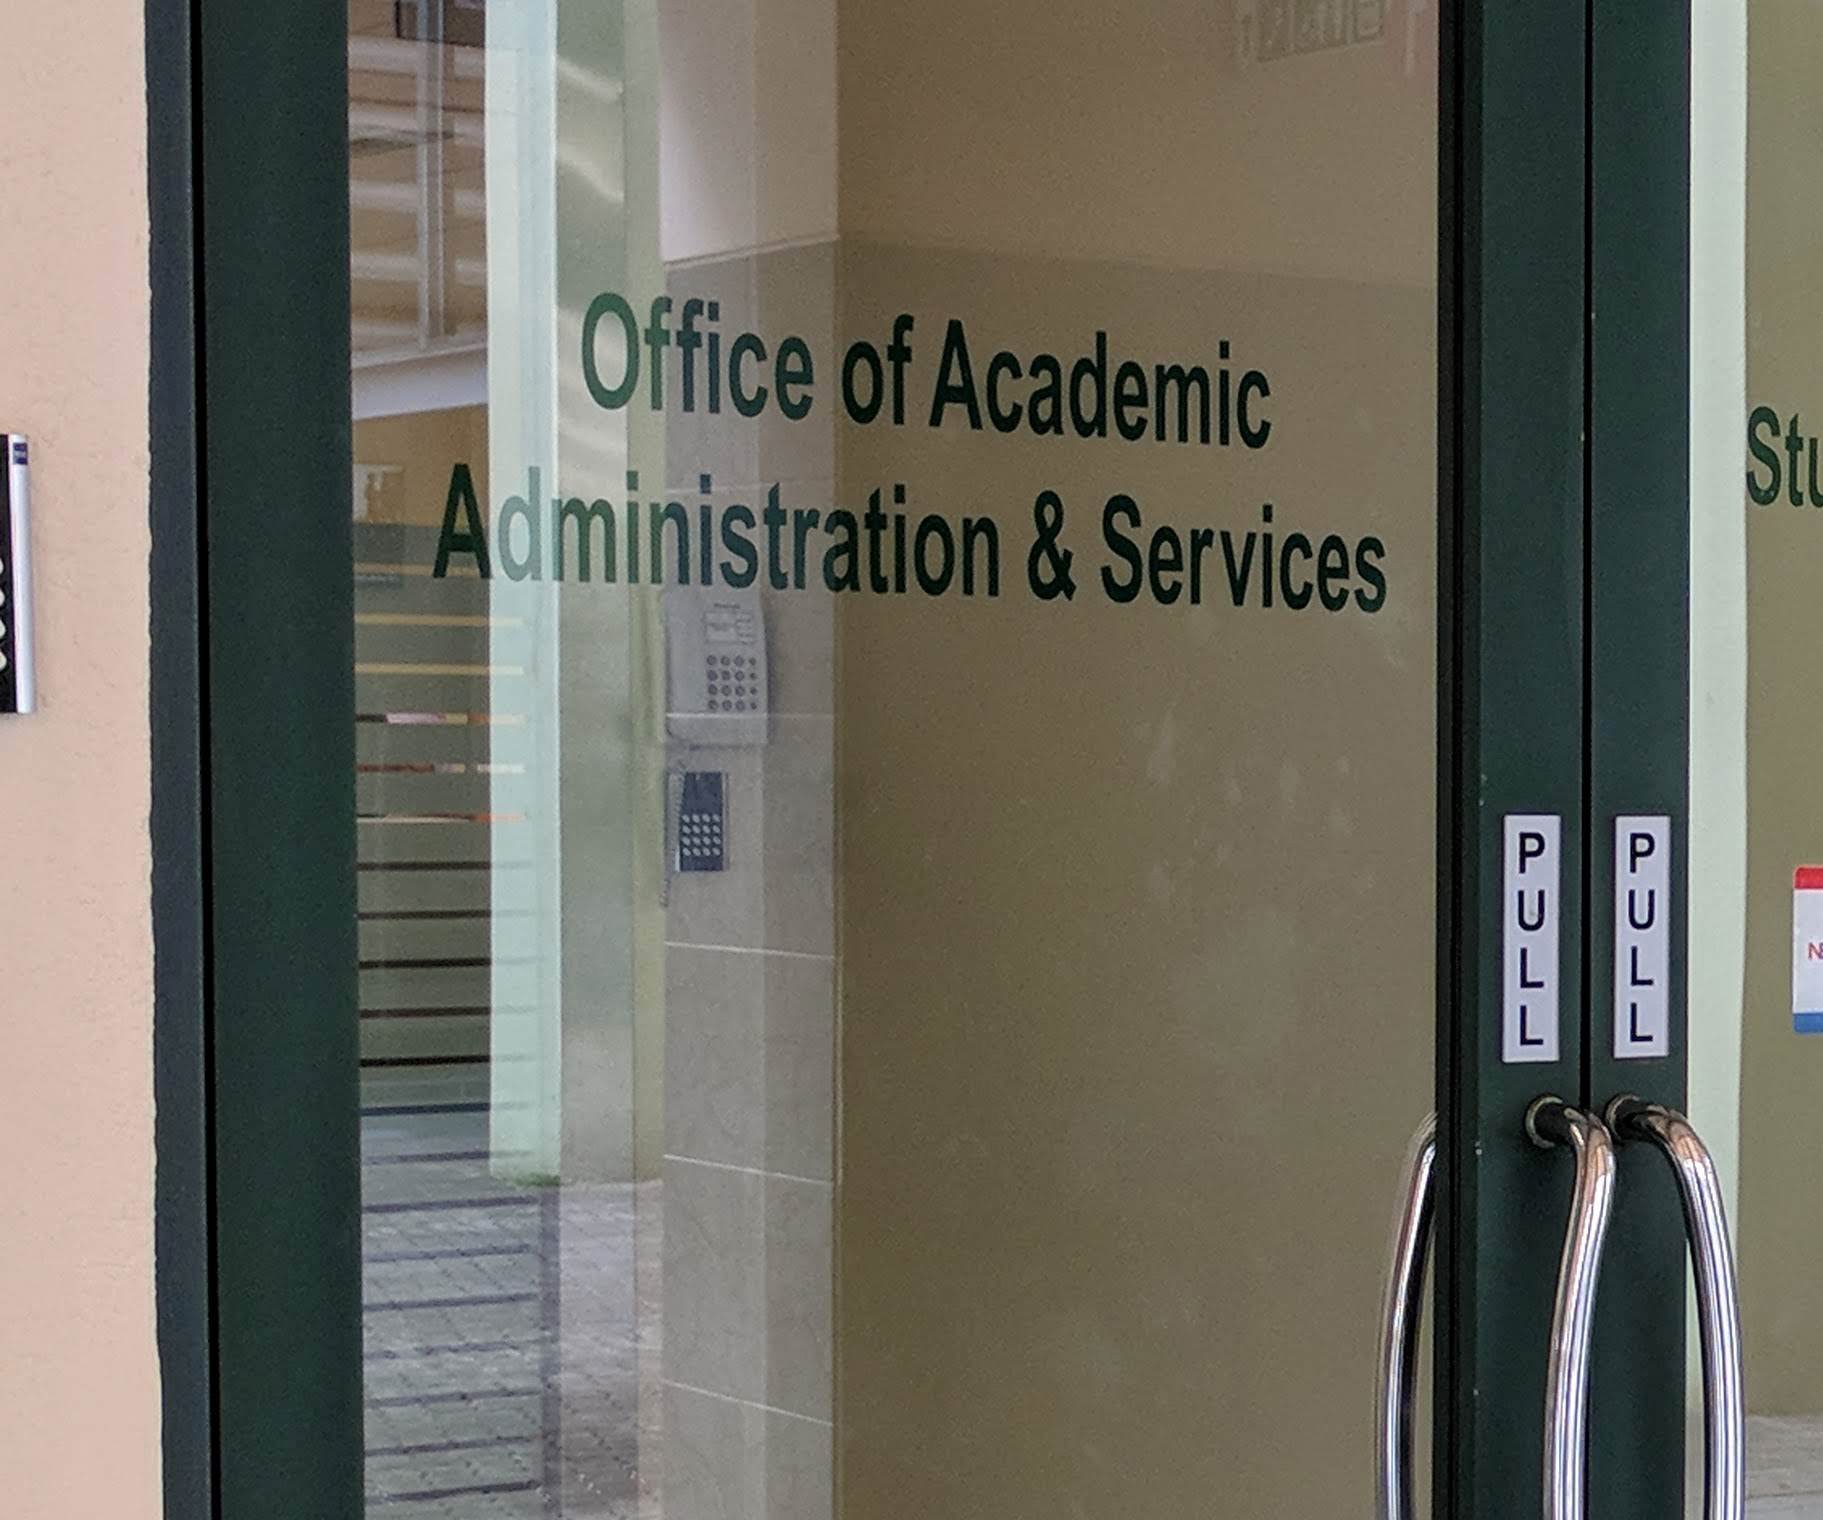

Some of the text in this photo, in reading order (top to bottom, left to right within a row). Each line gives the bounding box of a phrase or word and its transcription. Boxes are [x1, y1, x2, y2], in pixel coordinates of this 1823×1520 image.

[580, 290, 1272, 450] Office of Academic
[432, 462, 1388, 614] Administration & Services
[1517, 831, 1546, 1046] PULL
[1628, 832, 1656, 1043] PULL
